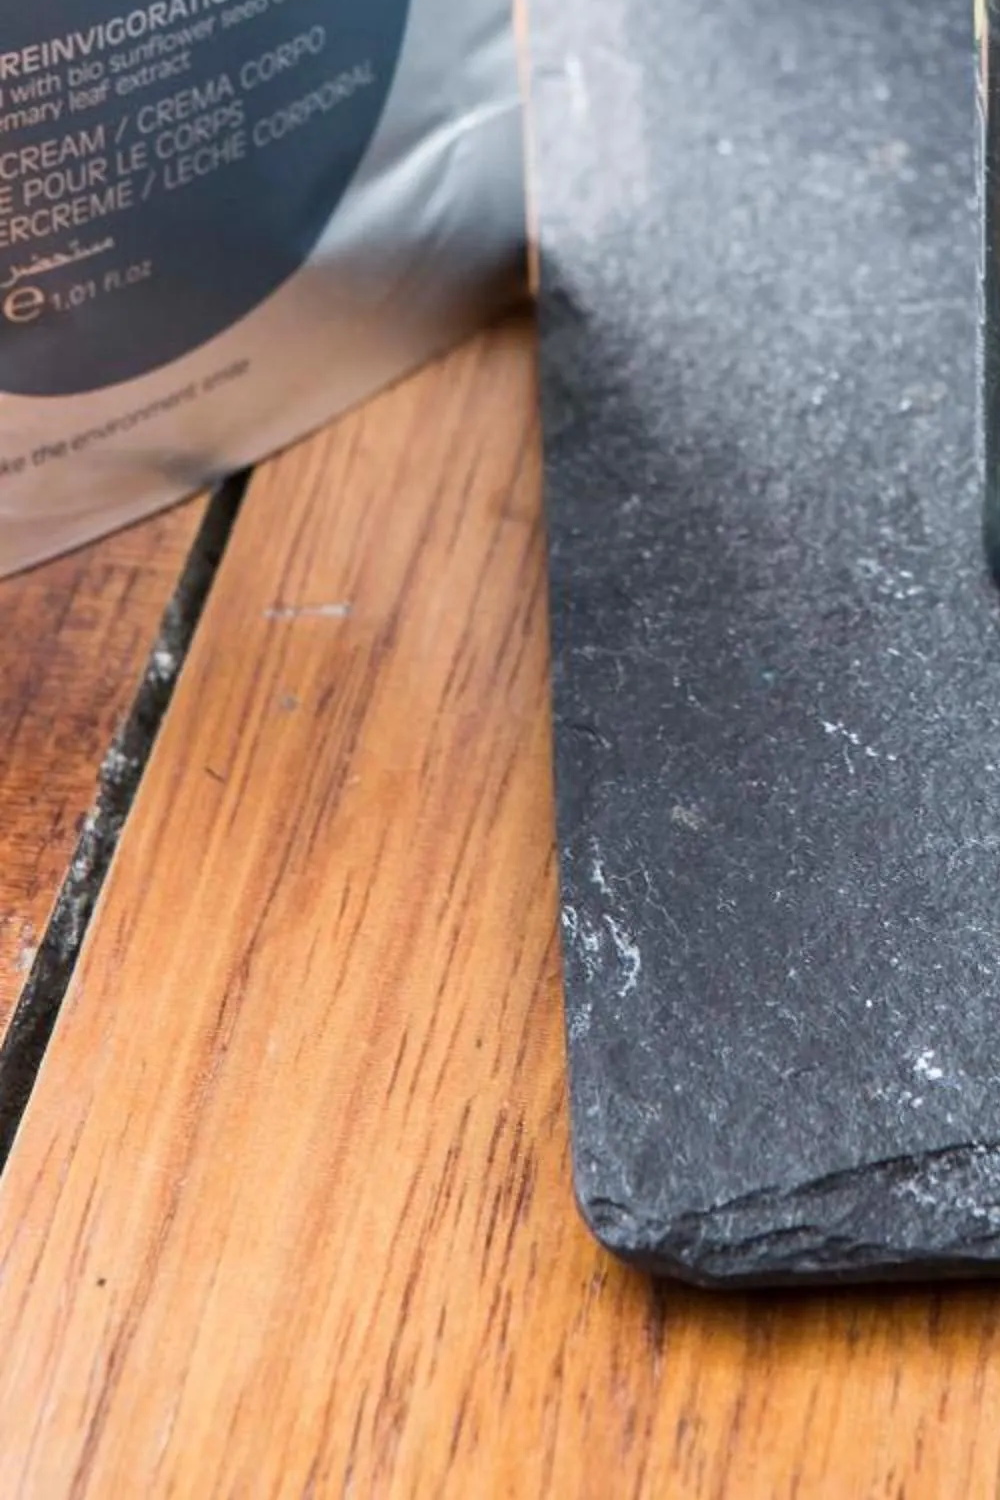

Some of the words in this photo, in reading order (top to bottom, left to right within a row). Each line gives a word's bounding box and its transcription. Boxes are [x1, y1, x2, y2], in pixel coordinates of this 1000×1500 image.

[0, 124, 106, 180] CREAM
[137, 75, 235, 134] CREMA
[239, 25, 327, 90] CORPO
[10, 72, 63, 105] with
[68, 60, 104, 88] bio
[109, 14, 217, 74] sunflower
[69, 77, 111, 113] leaf
[115, 51, 192, 96] extract
[23, 158, 108, 207] POUR
[117, 141, 148, 176] LE
[156, 102, 246, 160] CORPS
[163, 132, 247, 190] LECHE
[252, 60, 377, 147] CORPORAL
